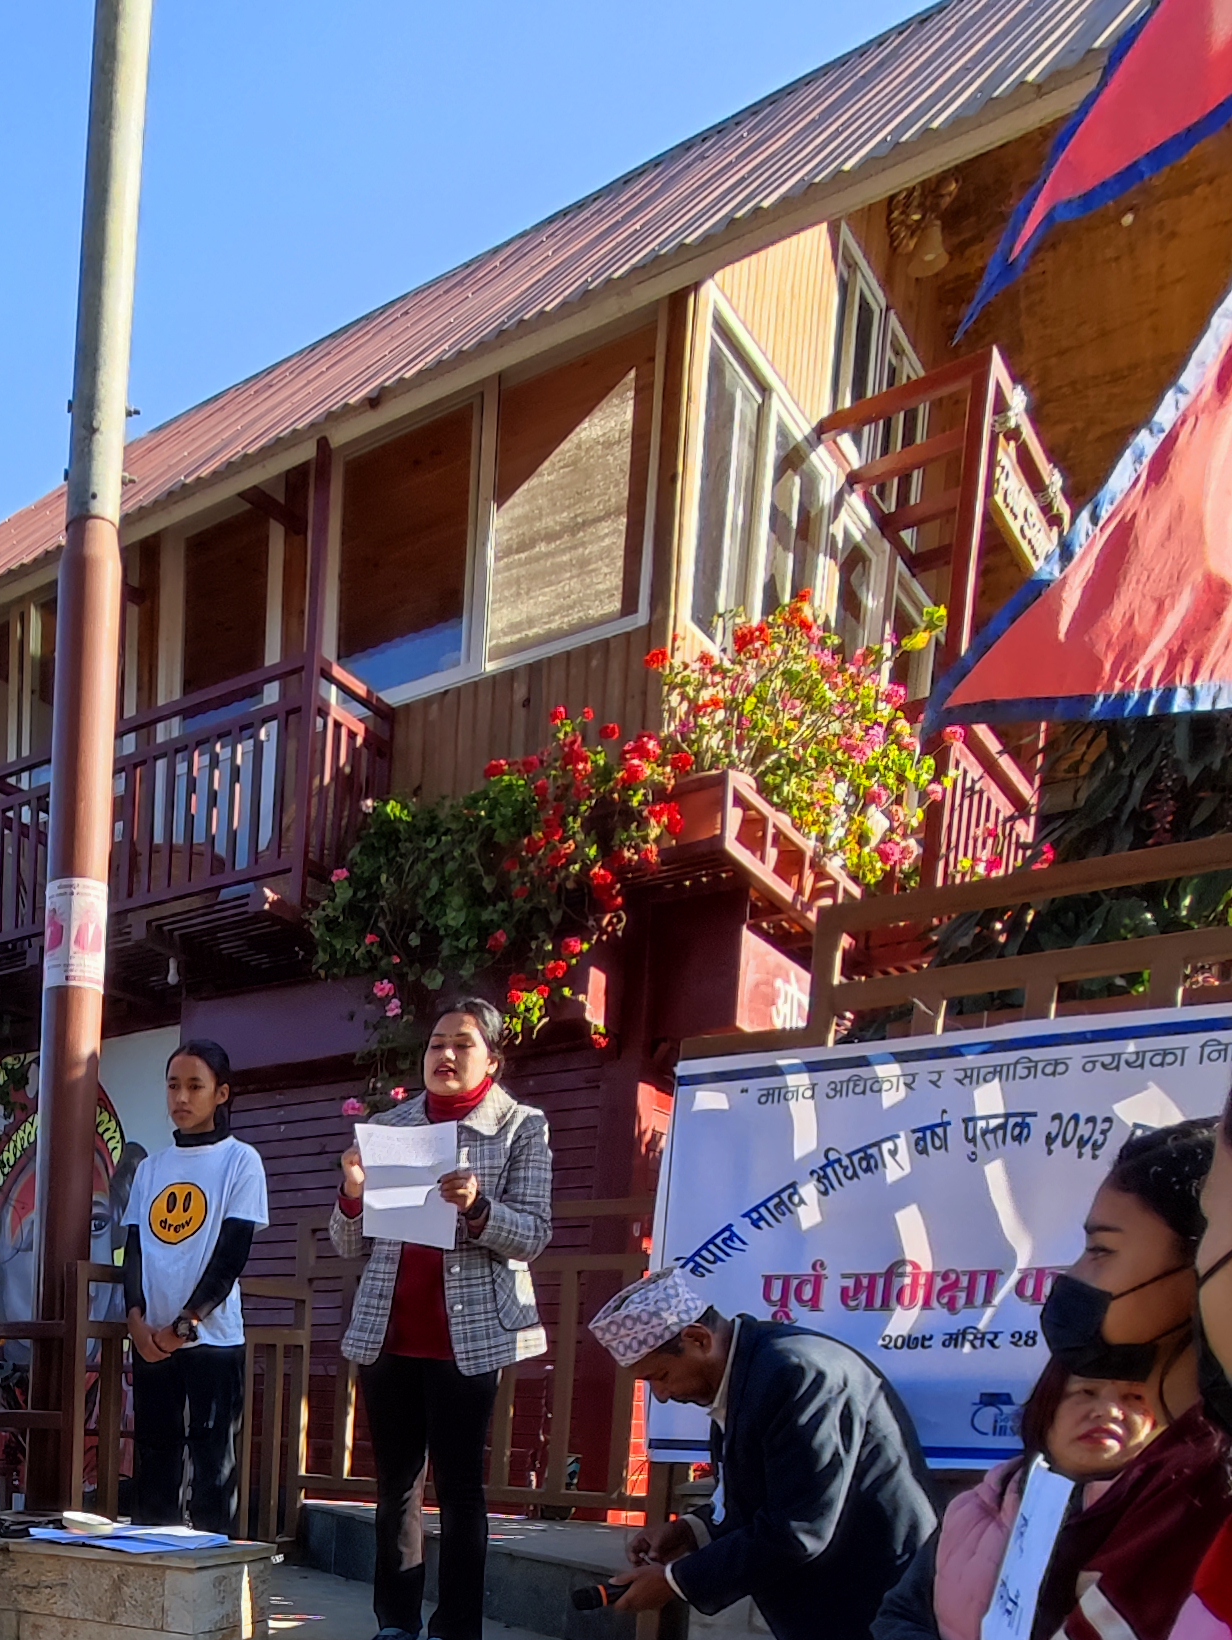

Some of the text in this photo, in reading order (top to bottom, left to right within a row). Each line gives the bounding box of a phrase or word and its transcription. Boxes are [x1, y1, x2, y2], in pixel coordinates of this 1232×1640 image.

[757, 1083, 819, 1105] मानव
[825, 1073, 919, 1099] अधिकार
[928, 1070, 945, 1089] र
[953, 1056, 1072, 1086] सामाजिक
[1199, 1038, 1232, 1066] नि
[159, 1216, 194, 1233] drew
[673, 1223, 749, 1279] नेपाल
[740, 1181, 808, 1230] मानव
[809, 1134, 905, 1197] अधिकार
[962, 1111, 1037, 1163] पुस्तक
[1045, 1112, 1114, 1160] २०२३
[761, 1258, 828, 1323] पूर्व
[840, 1260, 1005, 1315] समिक्षा
[881, 1325, 1038, 1350] २०७९ मंसिर २४
